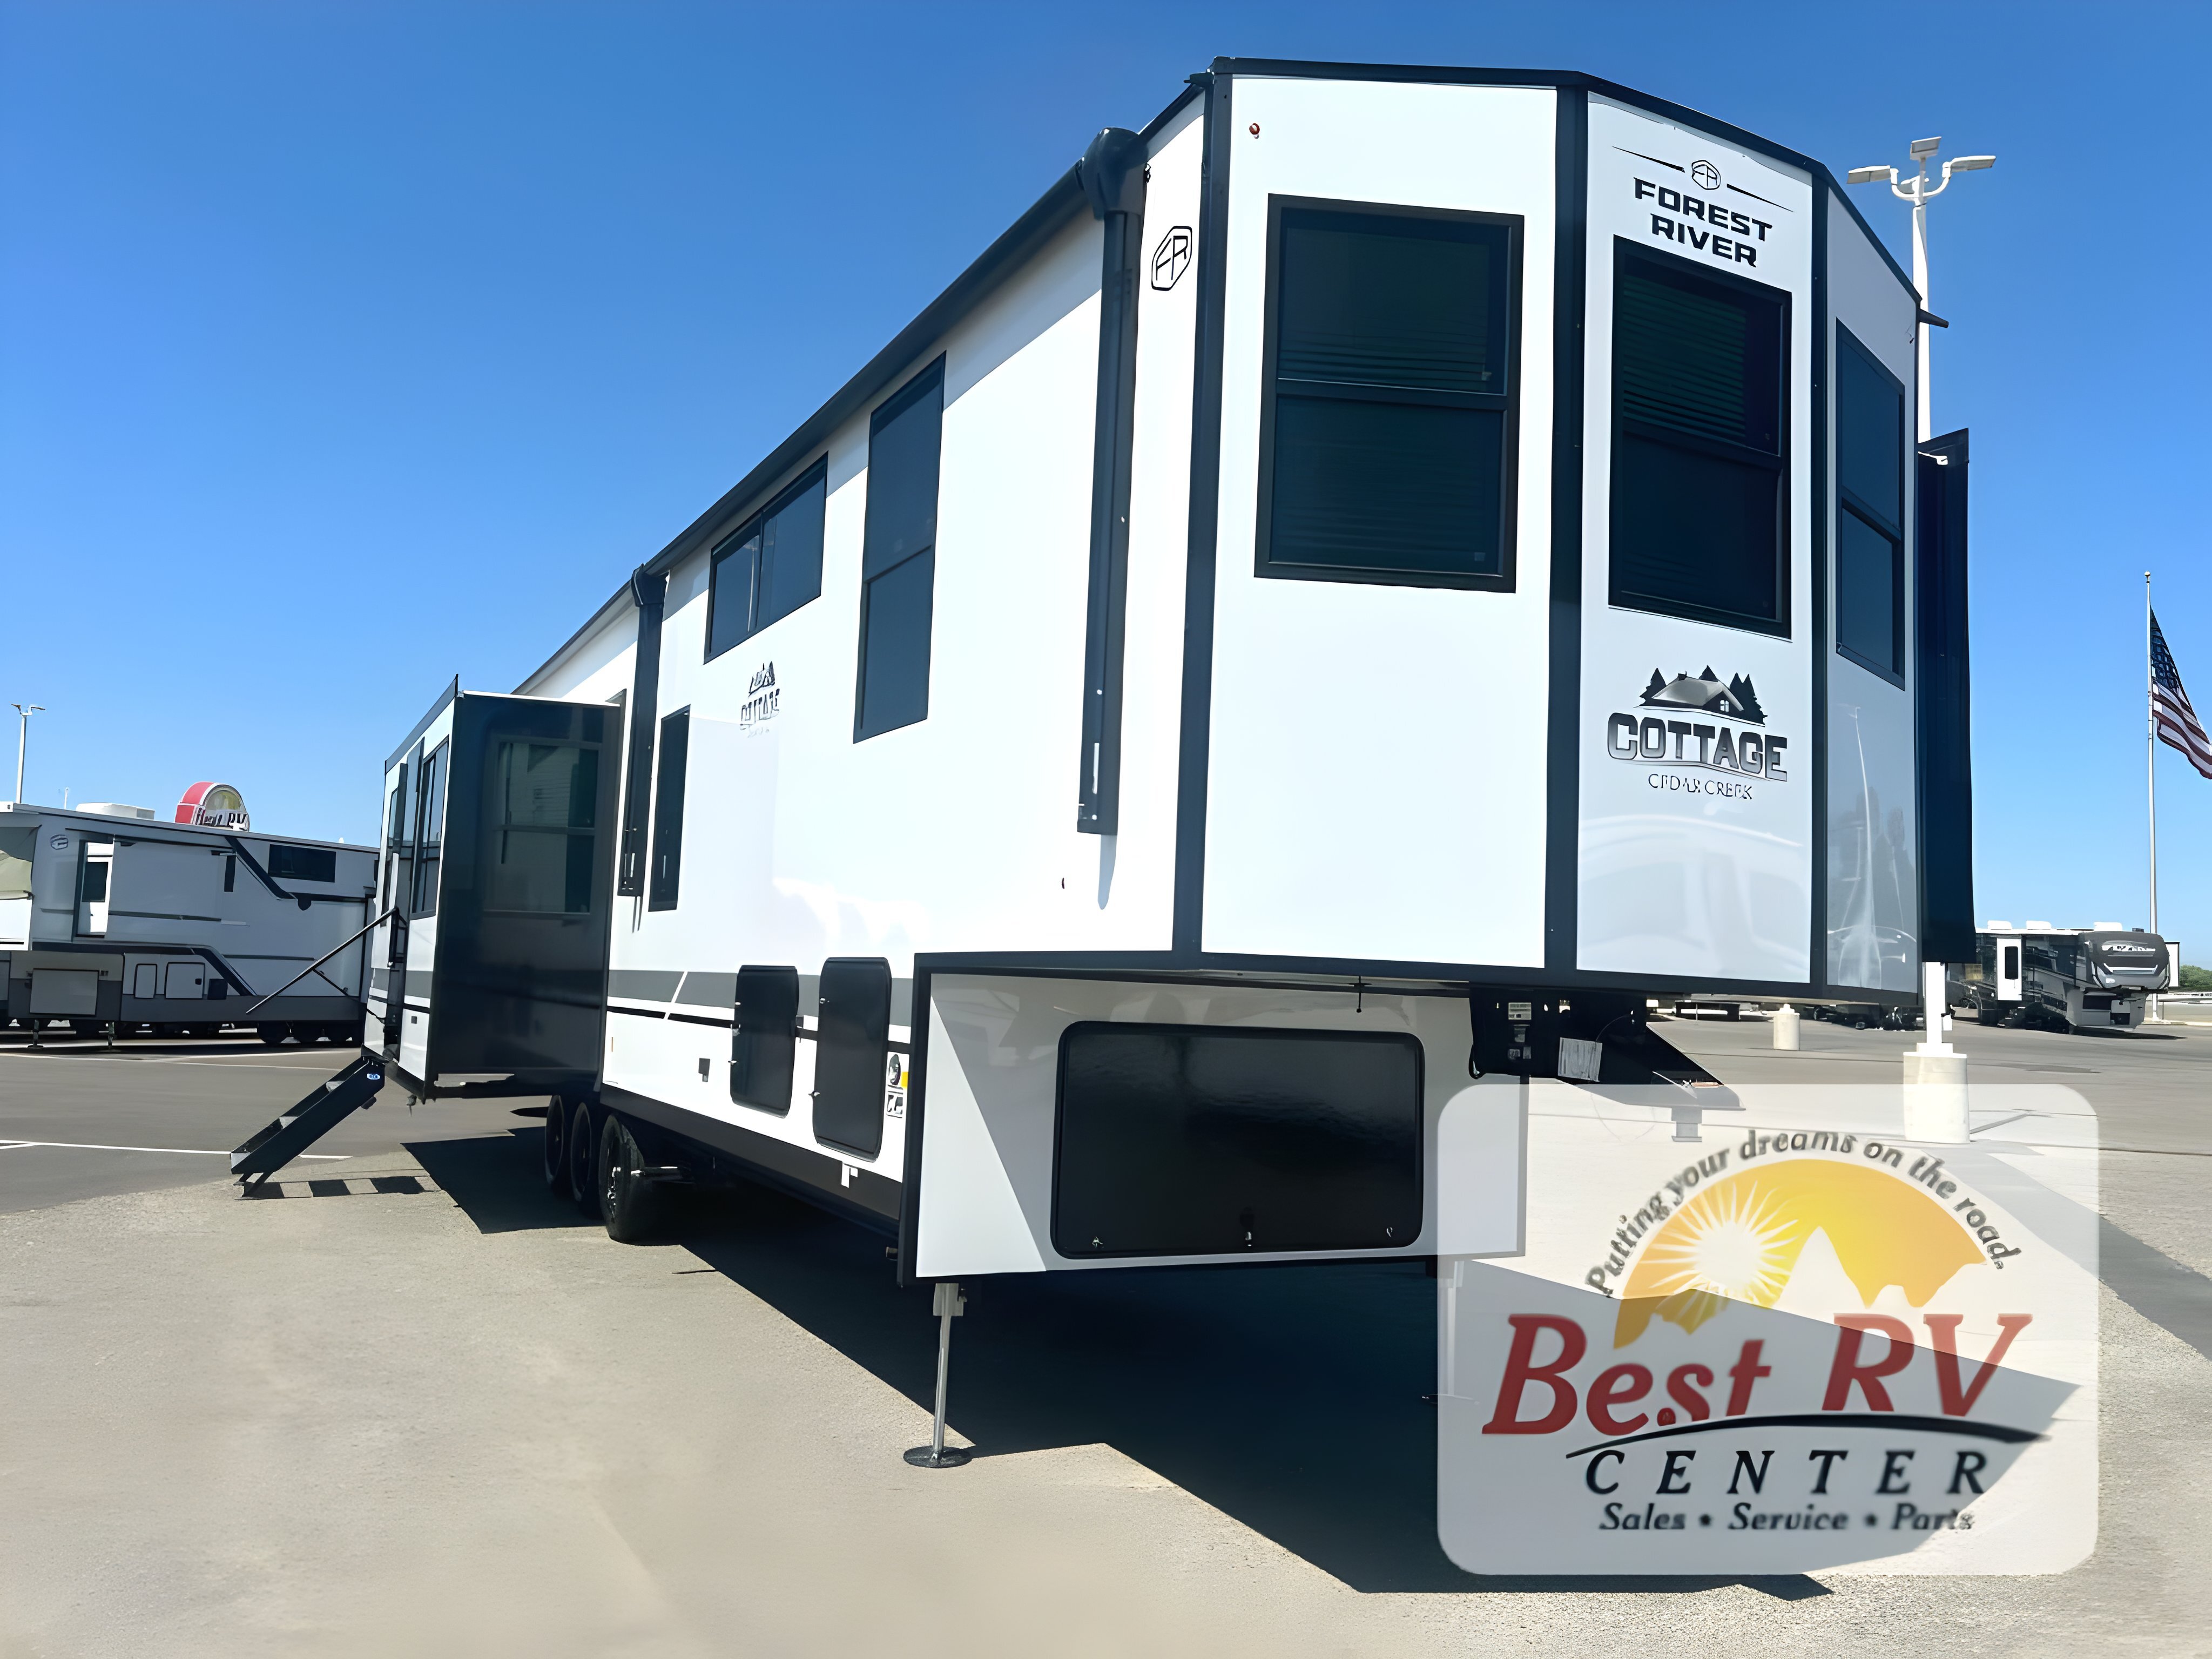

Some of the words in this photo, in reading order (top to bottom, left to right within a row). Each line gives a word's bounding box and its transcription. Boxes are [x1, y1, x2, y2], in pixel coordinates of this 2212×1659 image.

[1633, 177, 1773, 242] FOREST
[1650, 213, 1757, 268] RIVER
[1607, 712, 1788, 782] COTTAGE
